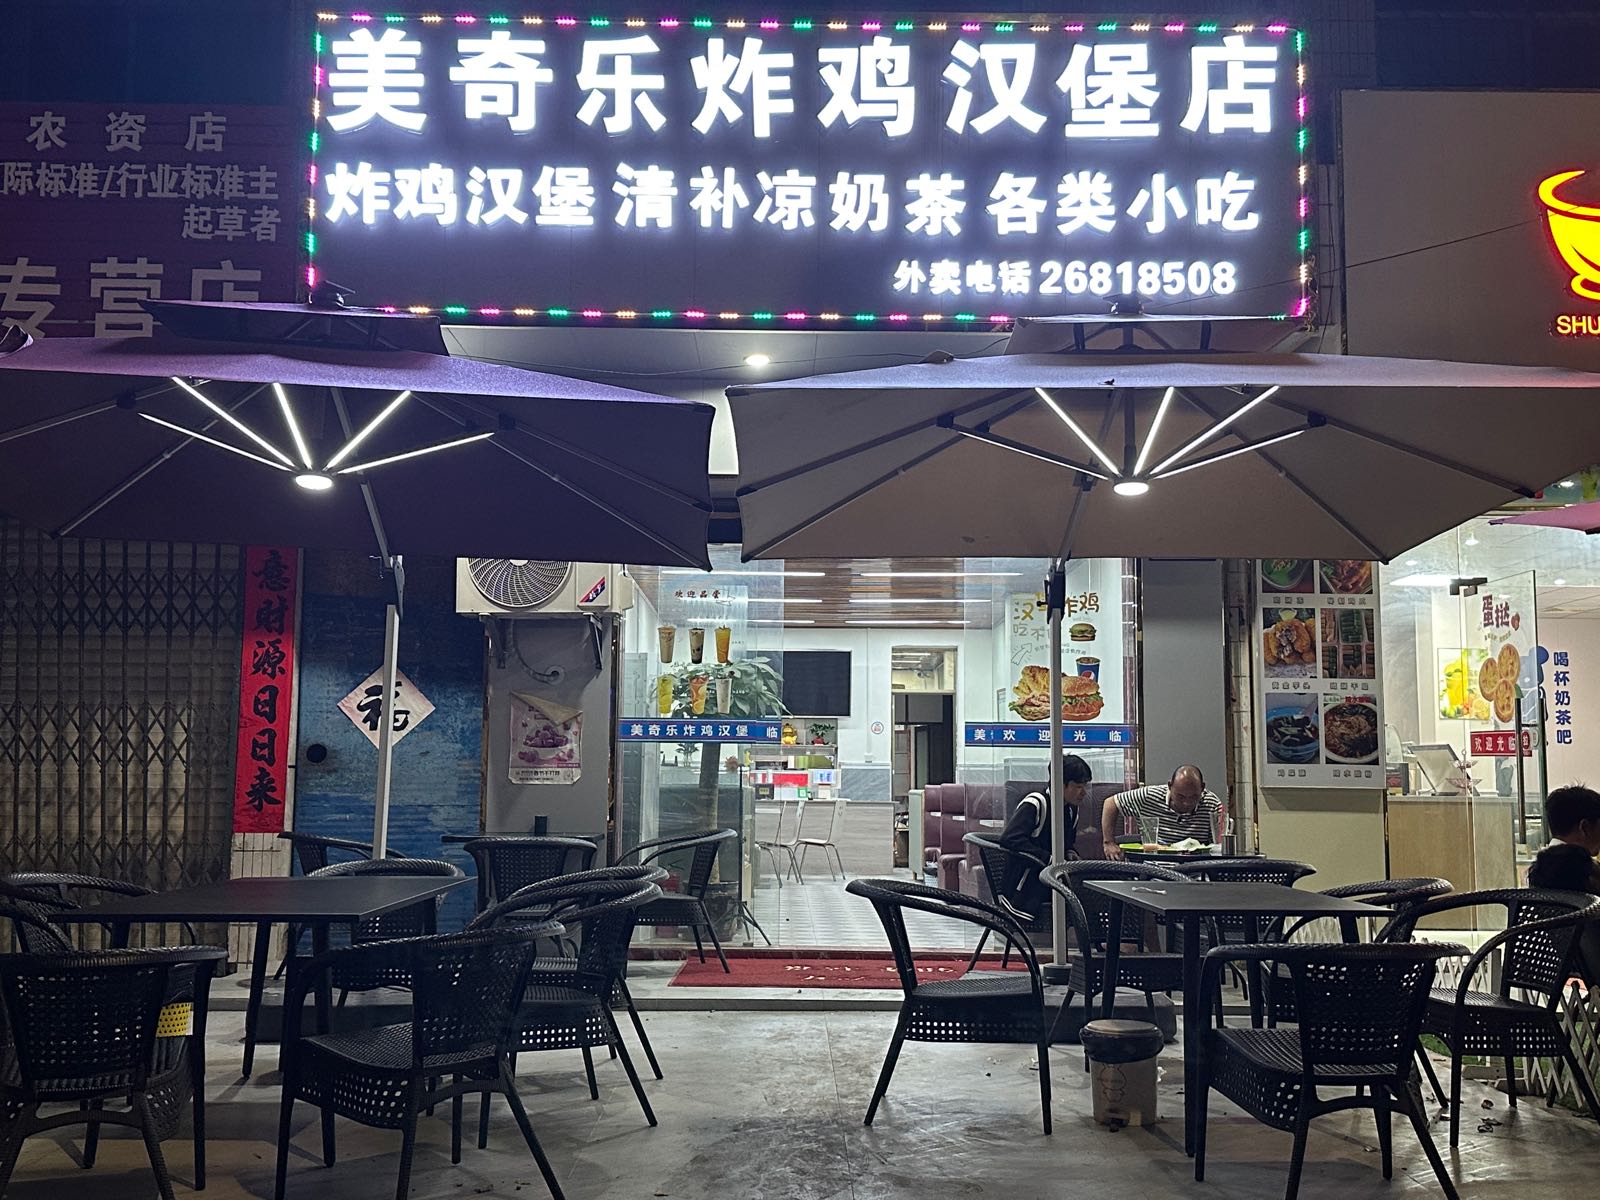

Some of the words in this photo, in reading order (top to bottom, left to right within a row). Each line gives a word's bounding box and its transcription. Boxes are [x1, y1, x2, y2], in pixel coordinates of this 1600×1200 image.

[326, 27, 1278, 137] 美奇乐炸鸡汉堡店
[26, 111, 226, 152] 农资店
[2, 161, 279, 200] 际标准/行业标准主
[181, 204, 281, 242] 起草者
[1482, 594, 1510, 628] 蛋挞
[1553, 651, 1572, 745] 喝杯奶茶吧
[630, 723, 749, 737] 美奇乐炸鸡汉堡
[766, 726, 778, 738] 临
